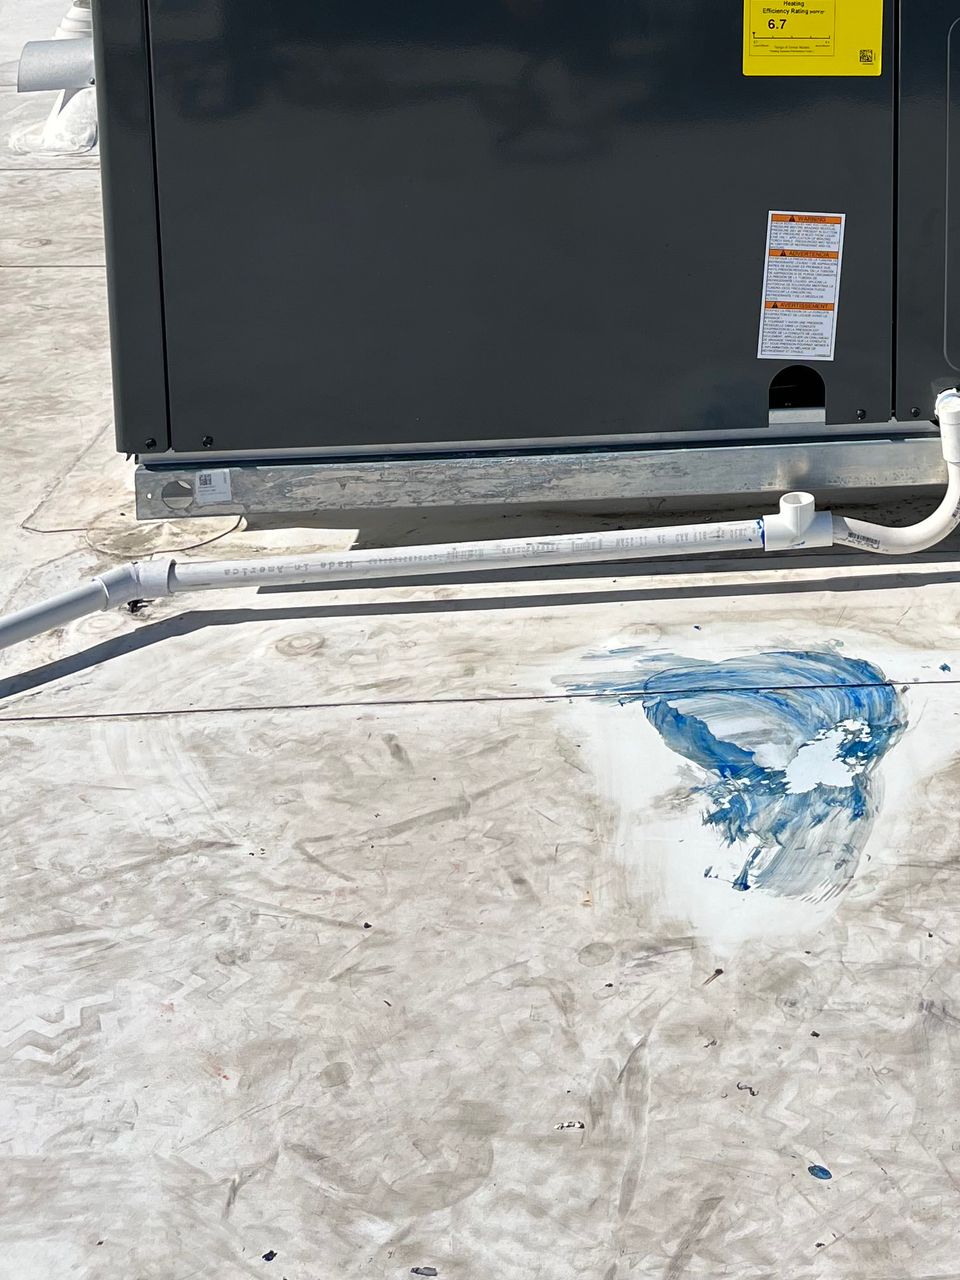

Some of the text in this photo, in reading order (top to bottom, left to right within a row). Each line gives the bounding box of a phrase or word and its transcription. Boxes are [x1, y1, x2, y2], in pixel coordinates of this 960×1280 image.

[768, 19, 787, 30] 6.7
[320, 560, 353, 569] Made
[223, 565, 284, 576] America
